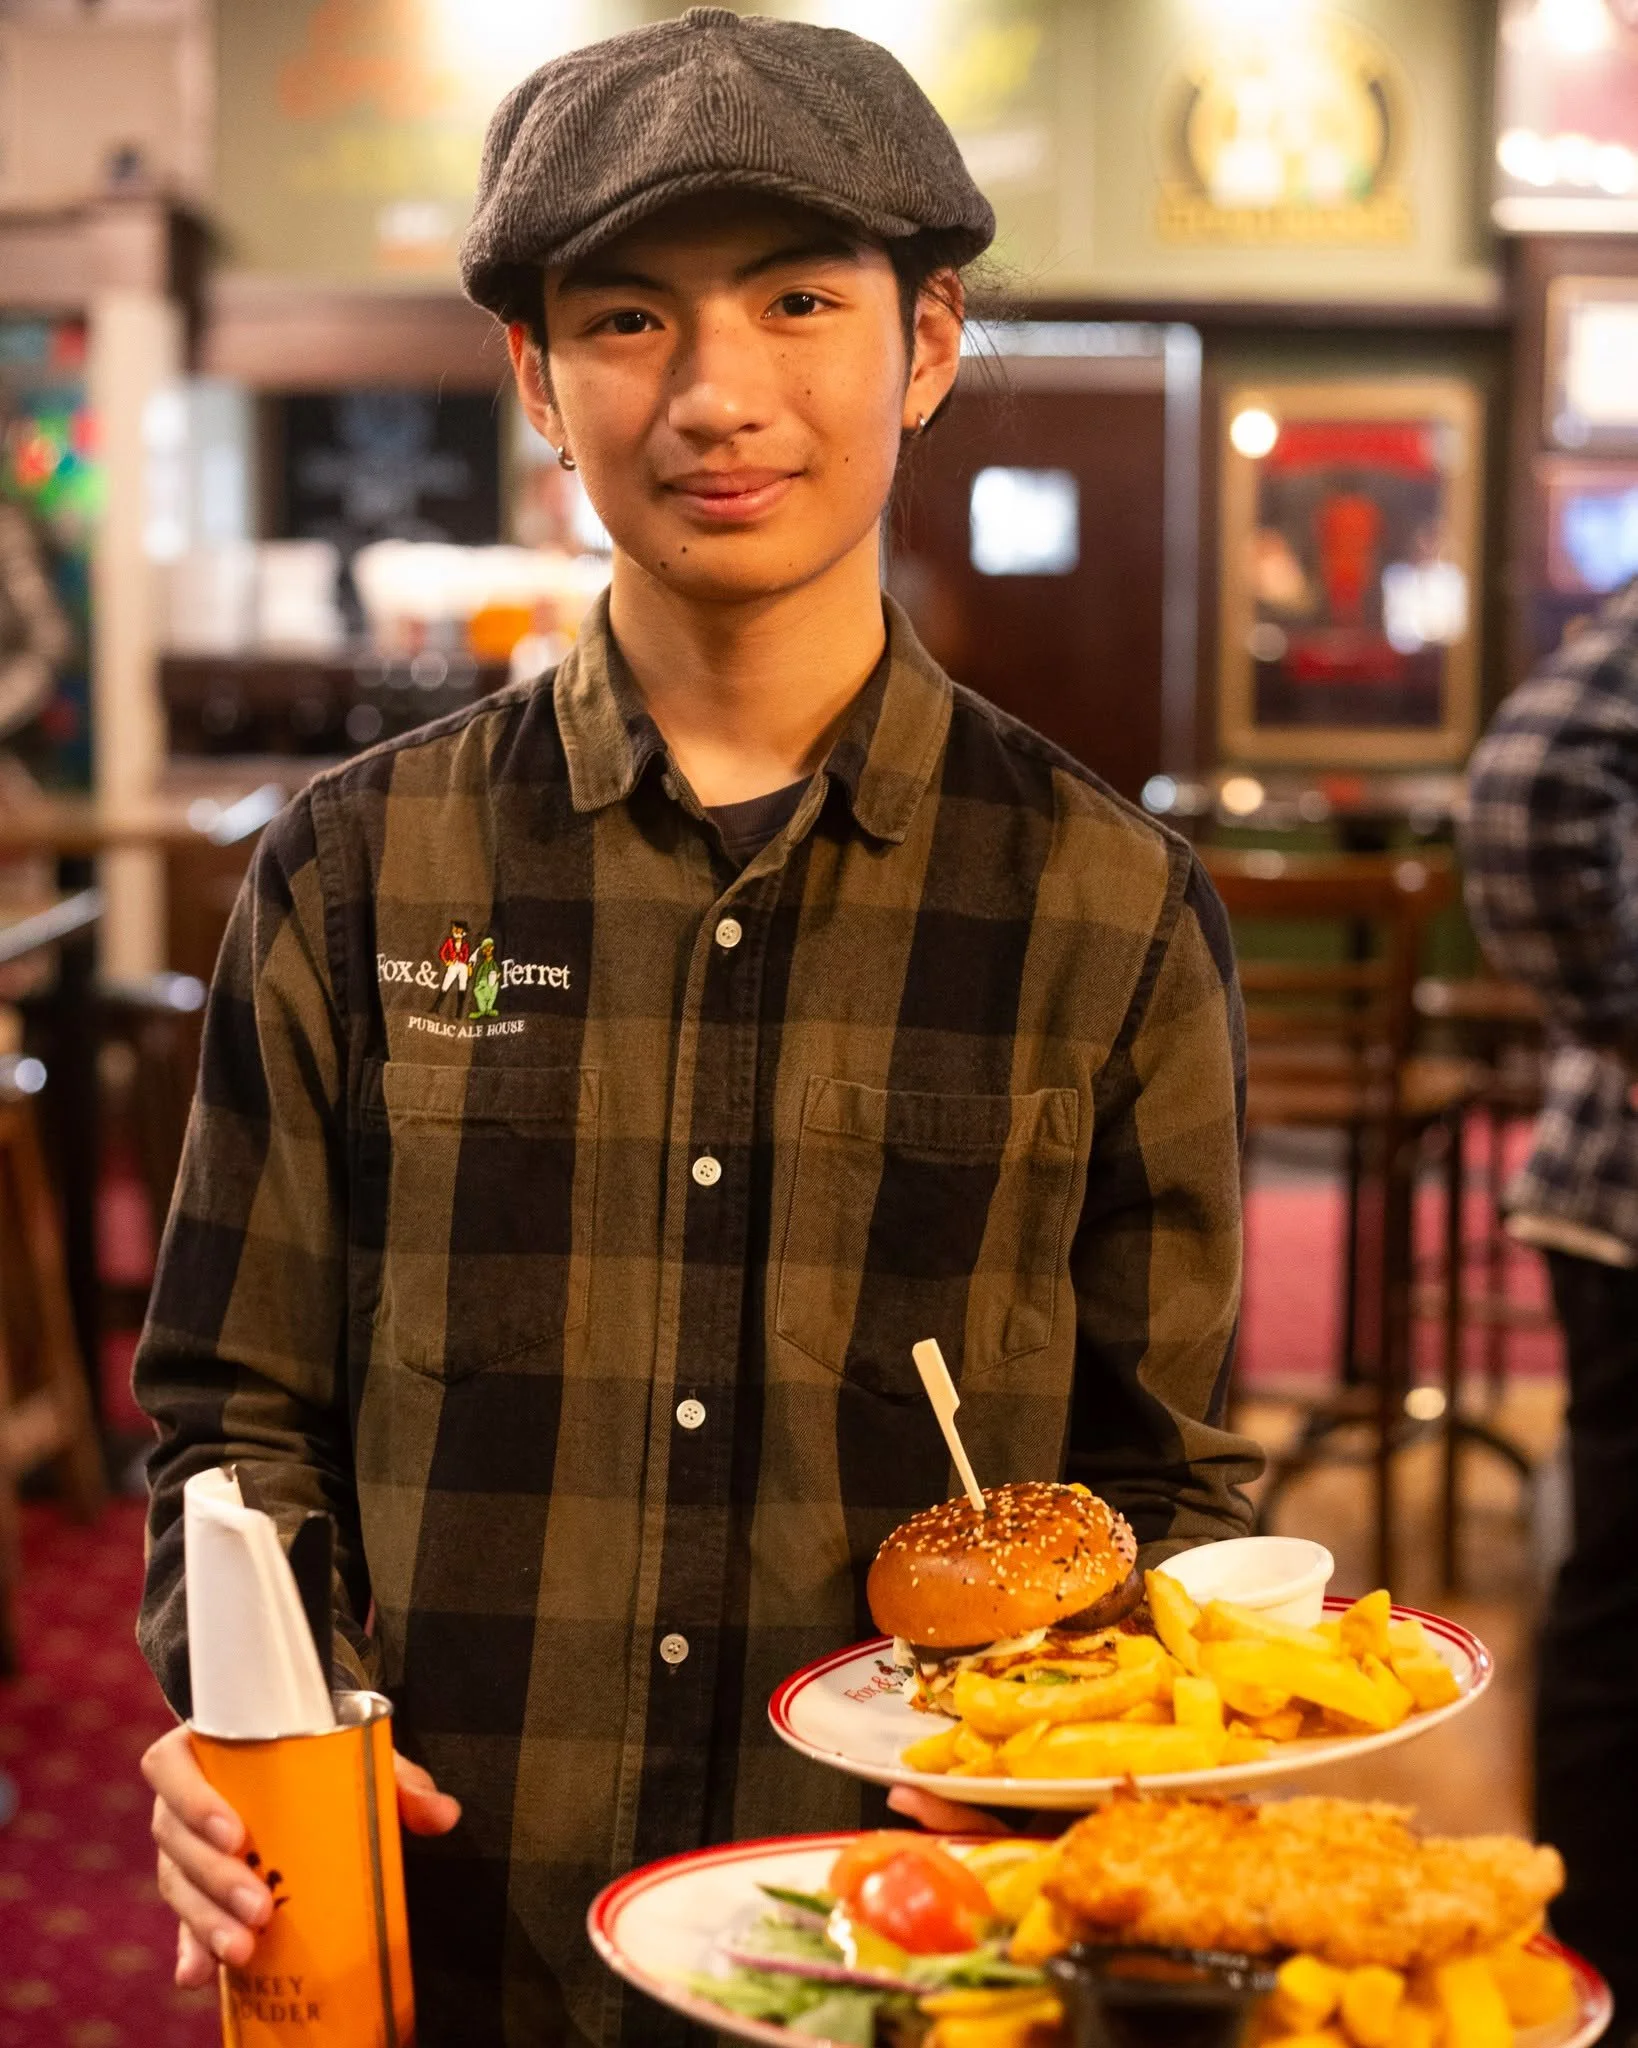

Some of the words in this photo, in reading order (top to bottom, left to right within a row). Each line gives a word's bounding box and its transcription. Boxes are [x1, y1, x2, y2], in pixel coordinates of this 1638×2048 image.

[376, 952, 414, 983] Fox
[415, 960, 440, 989] &
[500, 958, 571, 990] Ferret
[408, 1016, 457, 1037] PUBLIC
[457, 1025, 483, 1038] ALE
[486, 1020, 526, 1036] HOUSE
[844, 1684, 881, 1703] Fox
